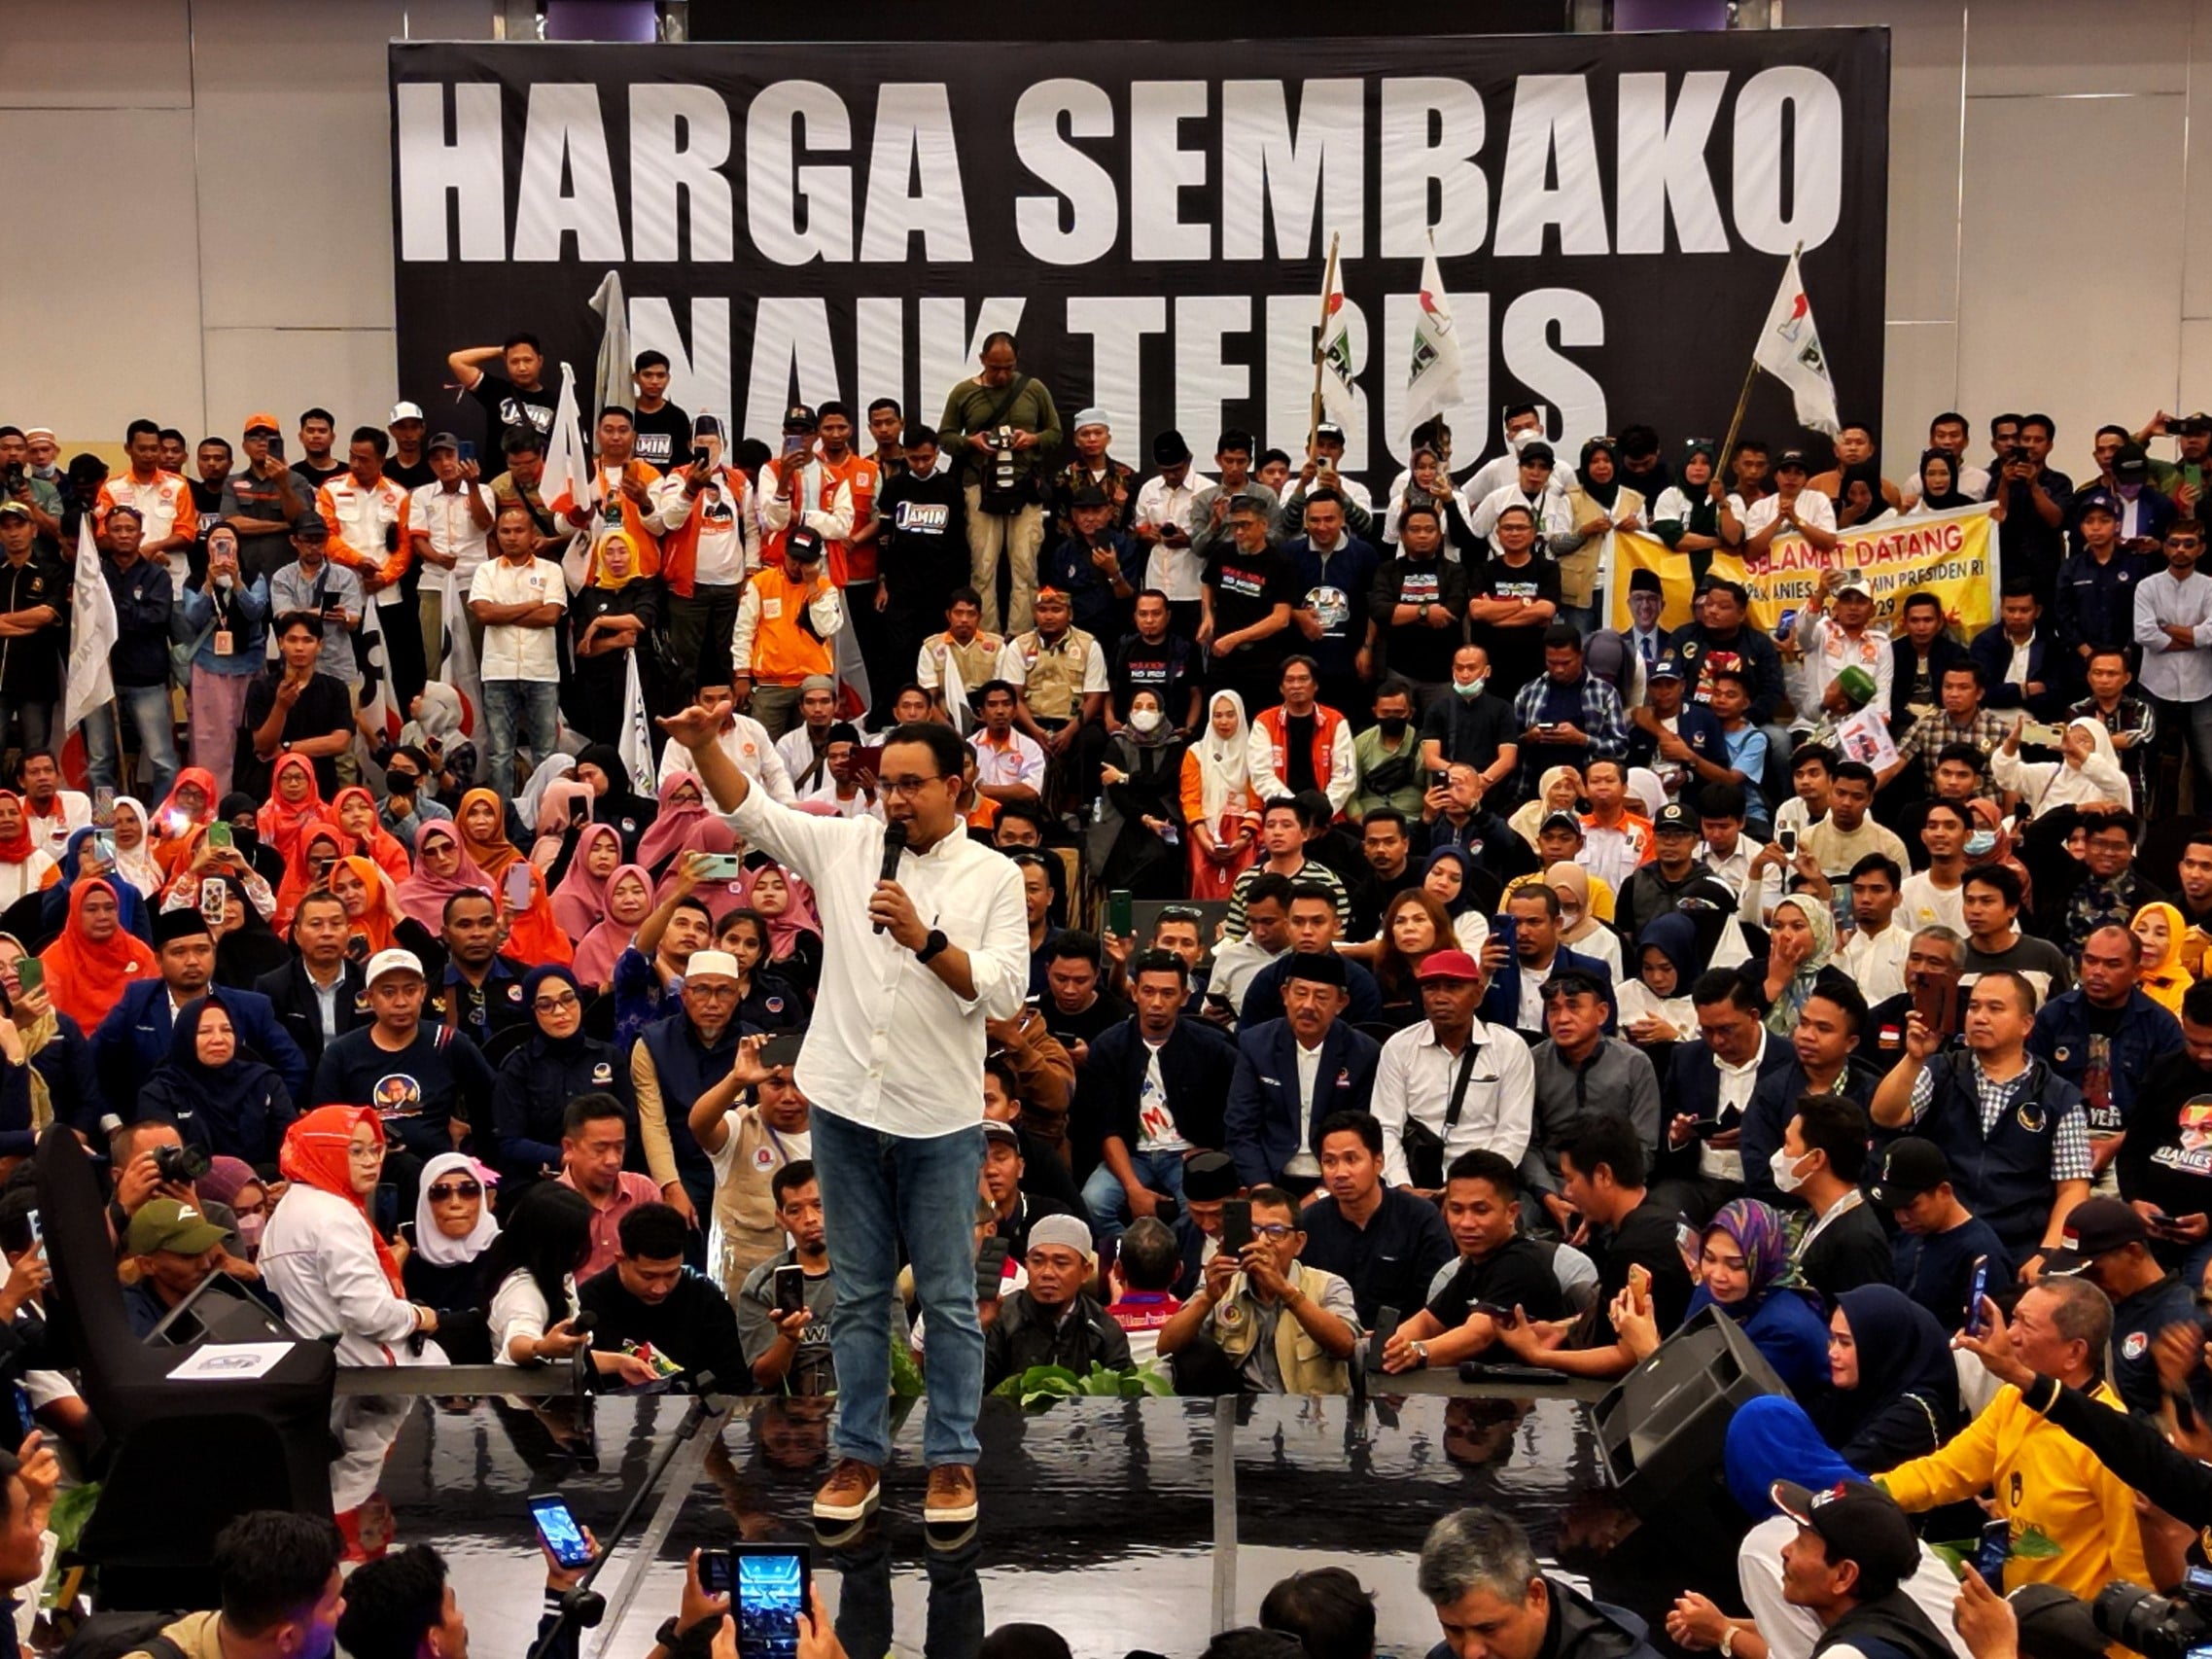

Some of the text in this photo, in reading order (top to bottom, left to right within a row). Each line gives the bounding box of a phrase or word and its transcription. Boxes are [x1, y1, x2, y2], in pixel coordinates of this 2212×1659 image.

[397, 65, 1843, 266] HARGA SEMBAKO
[1854, 523, 1963, 567] DATANG
[1898, 561, 1967, 588] PRESIDEN
[1971, 559, 1984, 577] RI
